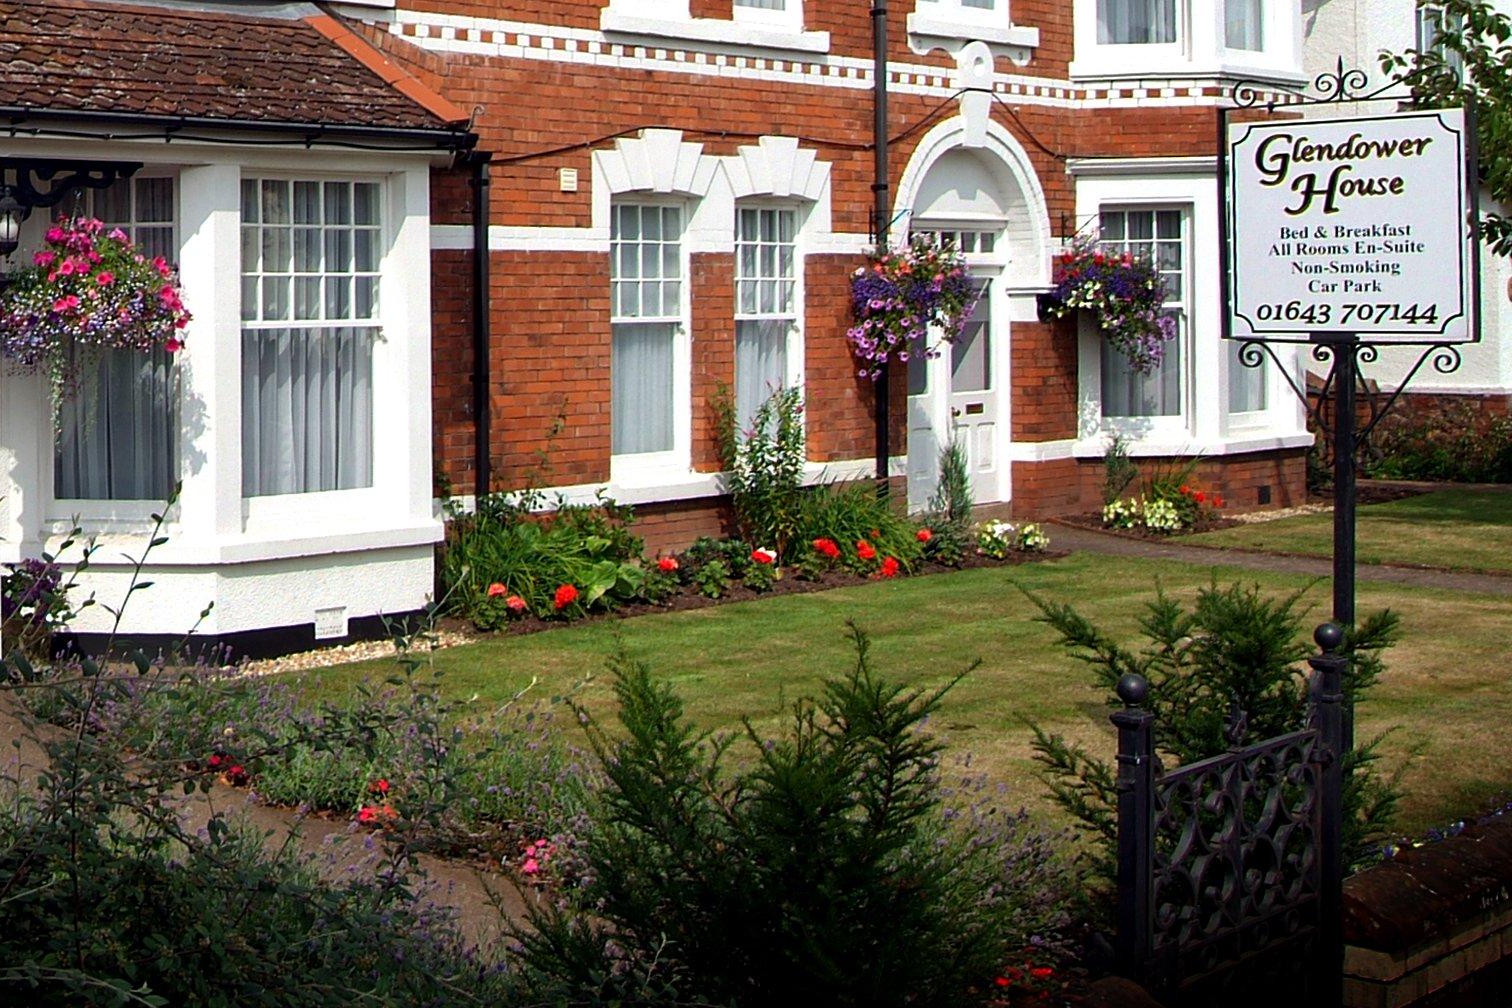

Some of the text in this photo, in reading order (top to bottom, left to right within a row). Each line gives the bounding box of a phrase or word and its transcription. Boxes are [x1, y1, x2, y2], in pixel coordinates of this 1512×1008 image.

[1255, 133, 1433, 186] Glendower
[1284, 164, 1405, 215] House
[1280, 223, 1411, 239] Bed & Breakfast
[1269, 239, 1425, 256] All Rooms En-Suite
[1291, 260, 1401, 275] Non-Smoking
[1308, 279, 1382, 293] Car Park
[1257, 301, 1439, 324] 01643 707144
